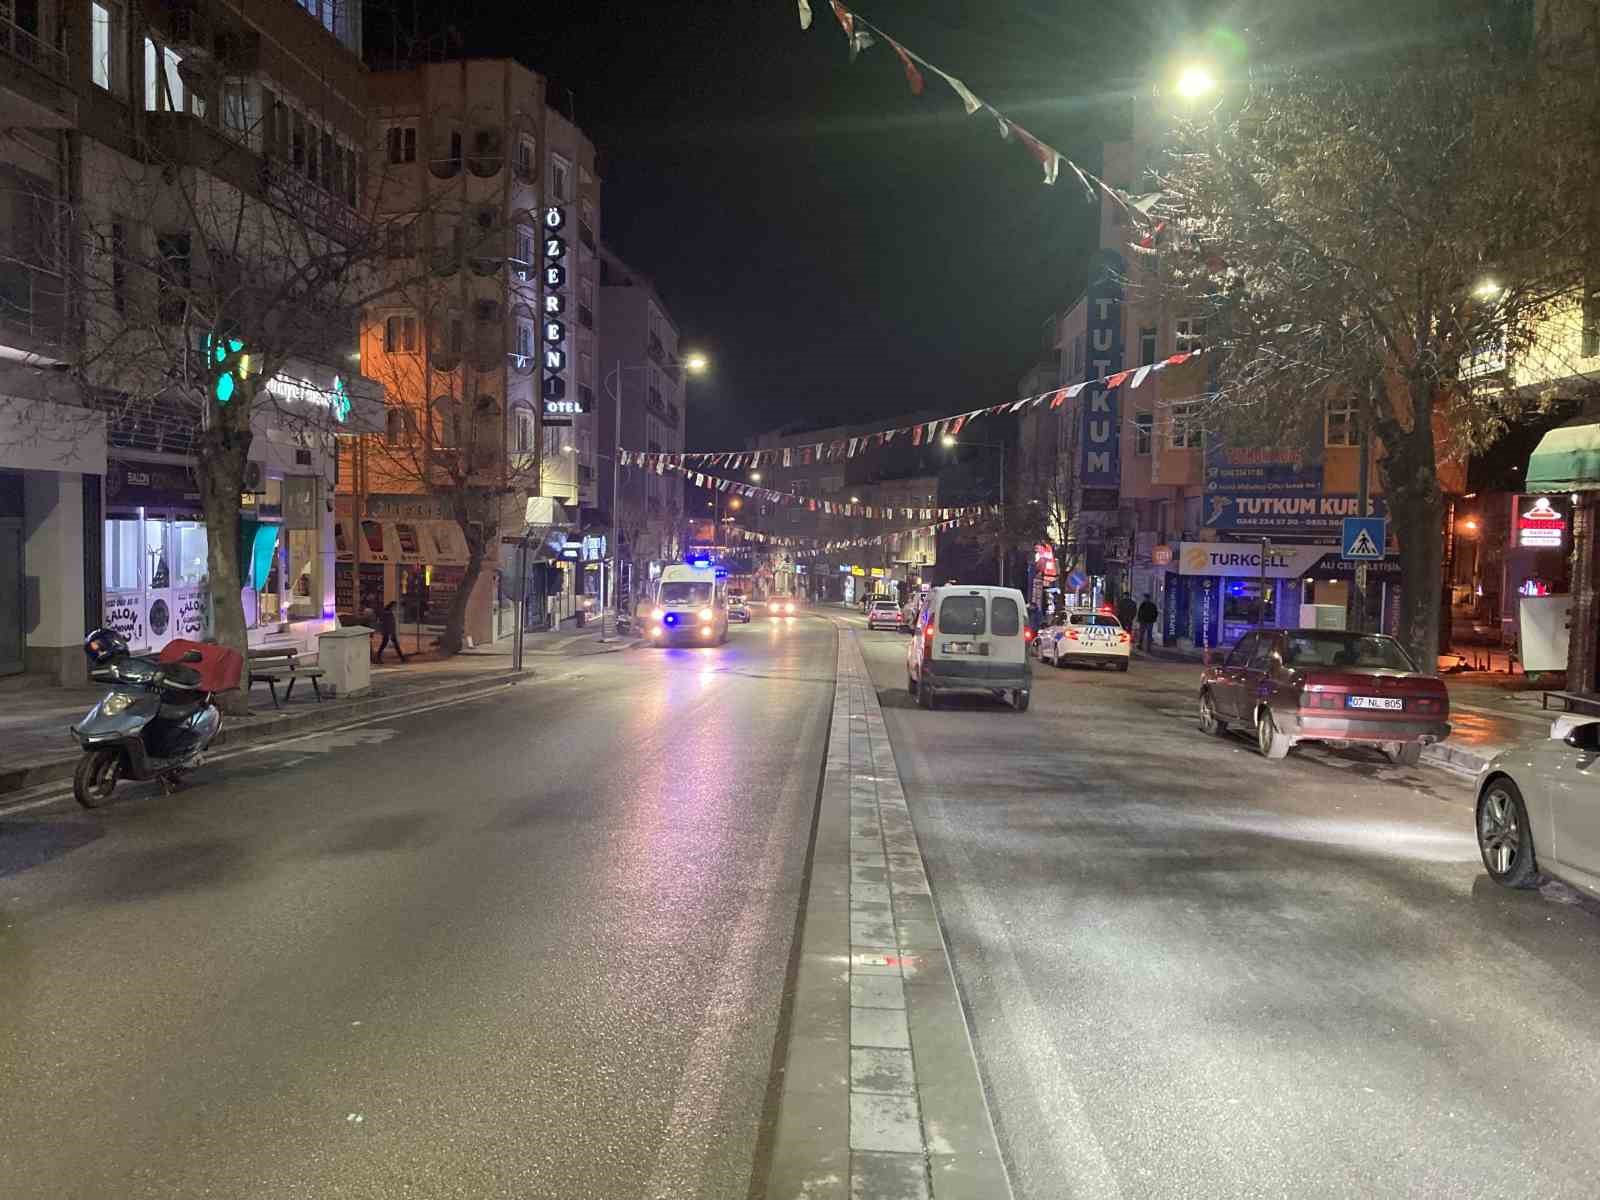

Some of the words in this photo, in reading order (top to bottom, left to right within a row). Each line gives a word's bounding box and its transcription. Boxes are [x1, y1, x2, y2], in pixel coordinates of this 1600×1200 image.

[545, 207, 561, 368] ÖZEREN
[1087, 298, 1114, 473] TUTKUM
[547, 402, 583, 413] OTEL
[1236, 497, 1316, 515] TUTKUM
[105, 608, 138, 627] SALON
[1352, 697, 1364, 706] 07
